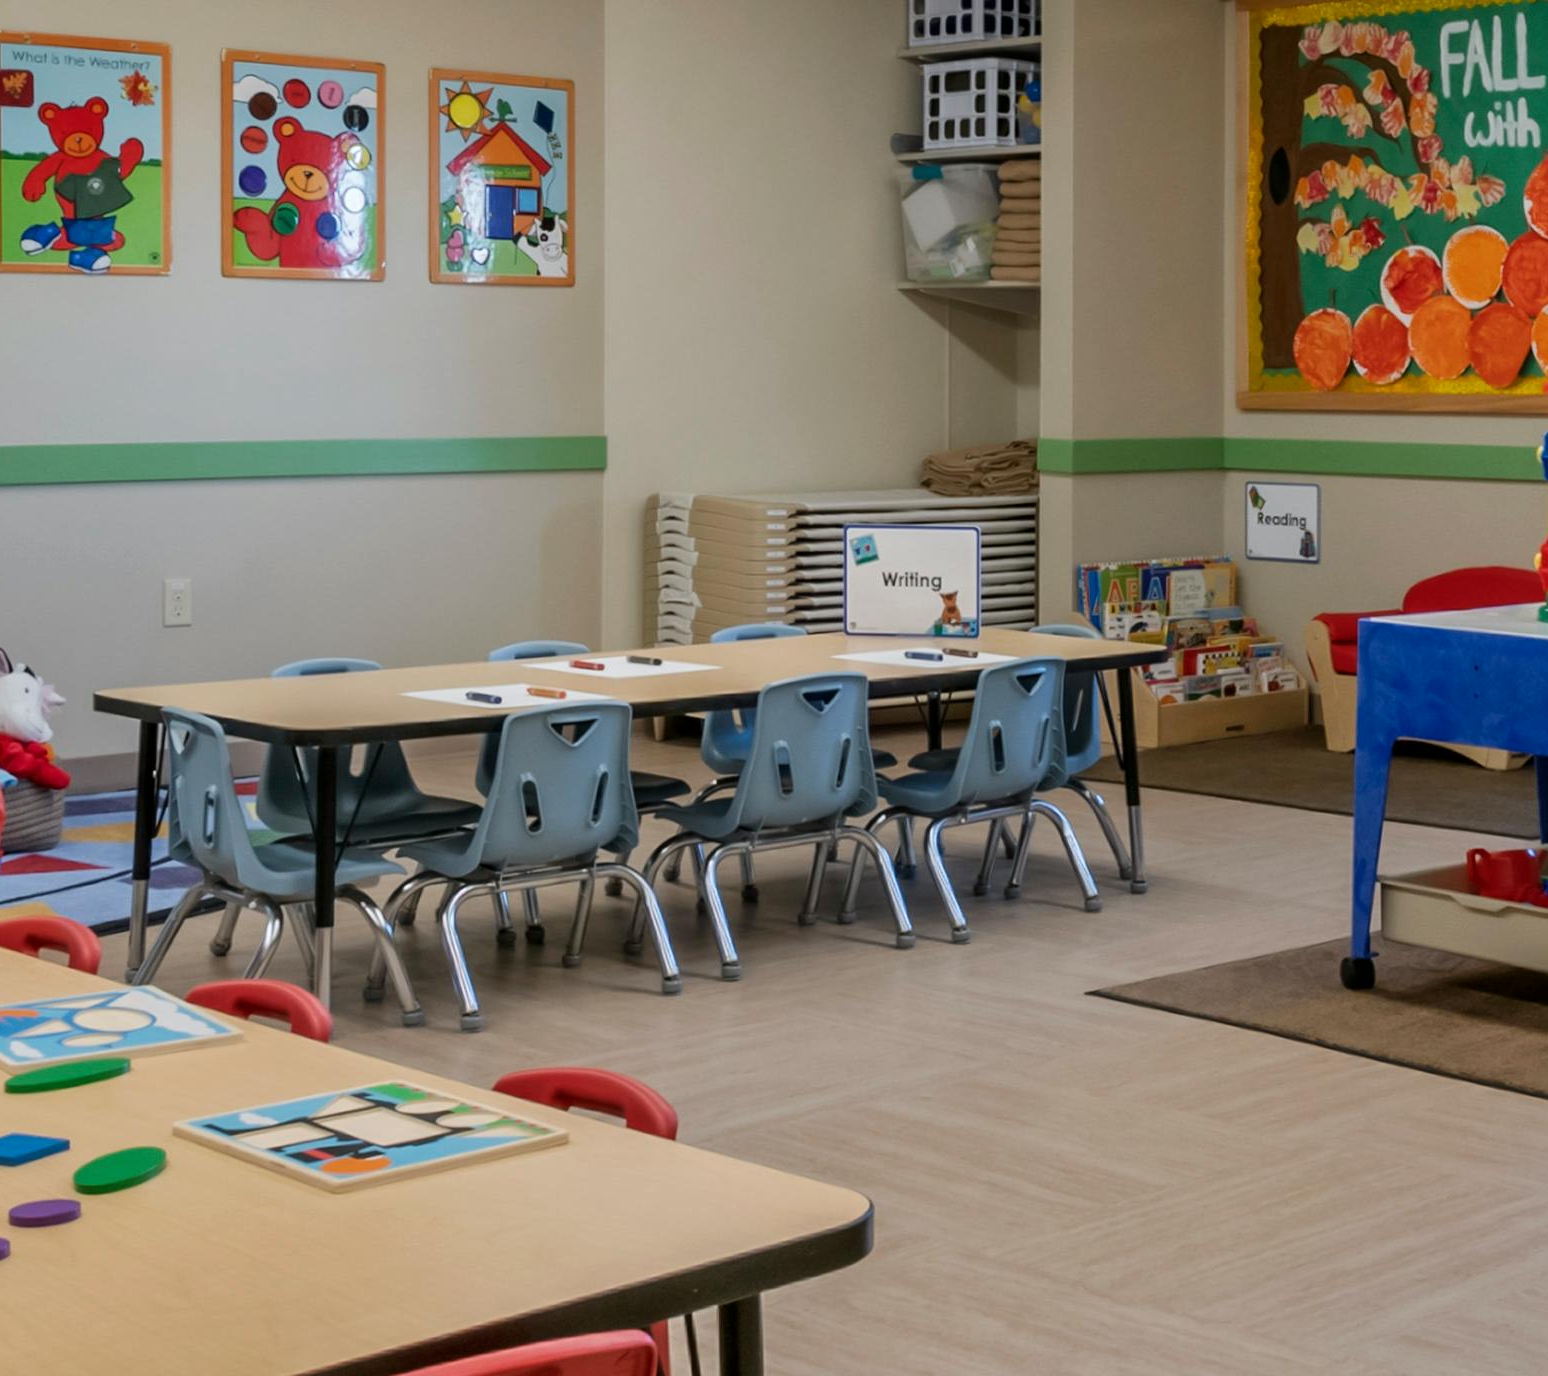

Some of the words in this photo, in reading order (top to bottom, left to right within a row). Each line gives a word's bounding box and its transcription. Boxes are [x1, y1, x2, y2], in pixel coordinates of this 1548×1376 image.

[12, 49, 47, 64] What
[51, 51, 60, 65] is
[64, 51, 85, 68] the
[89, 56, 151, 72] Weather?
[1439, 11, 1546, 98] FALL
[1463, 96, 1542, 149] with
[1257, 511, 1307, 531] Reading
[881, 571, 943, 592] Writing
